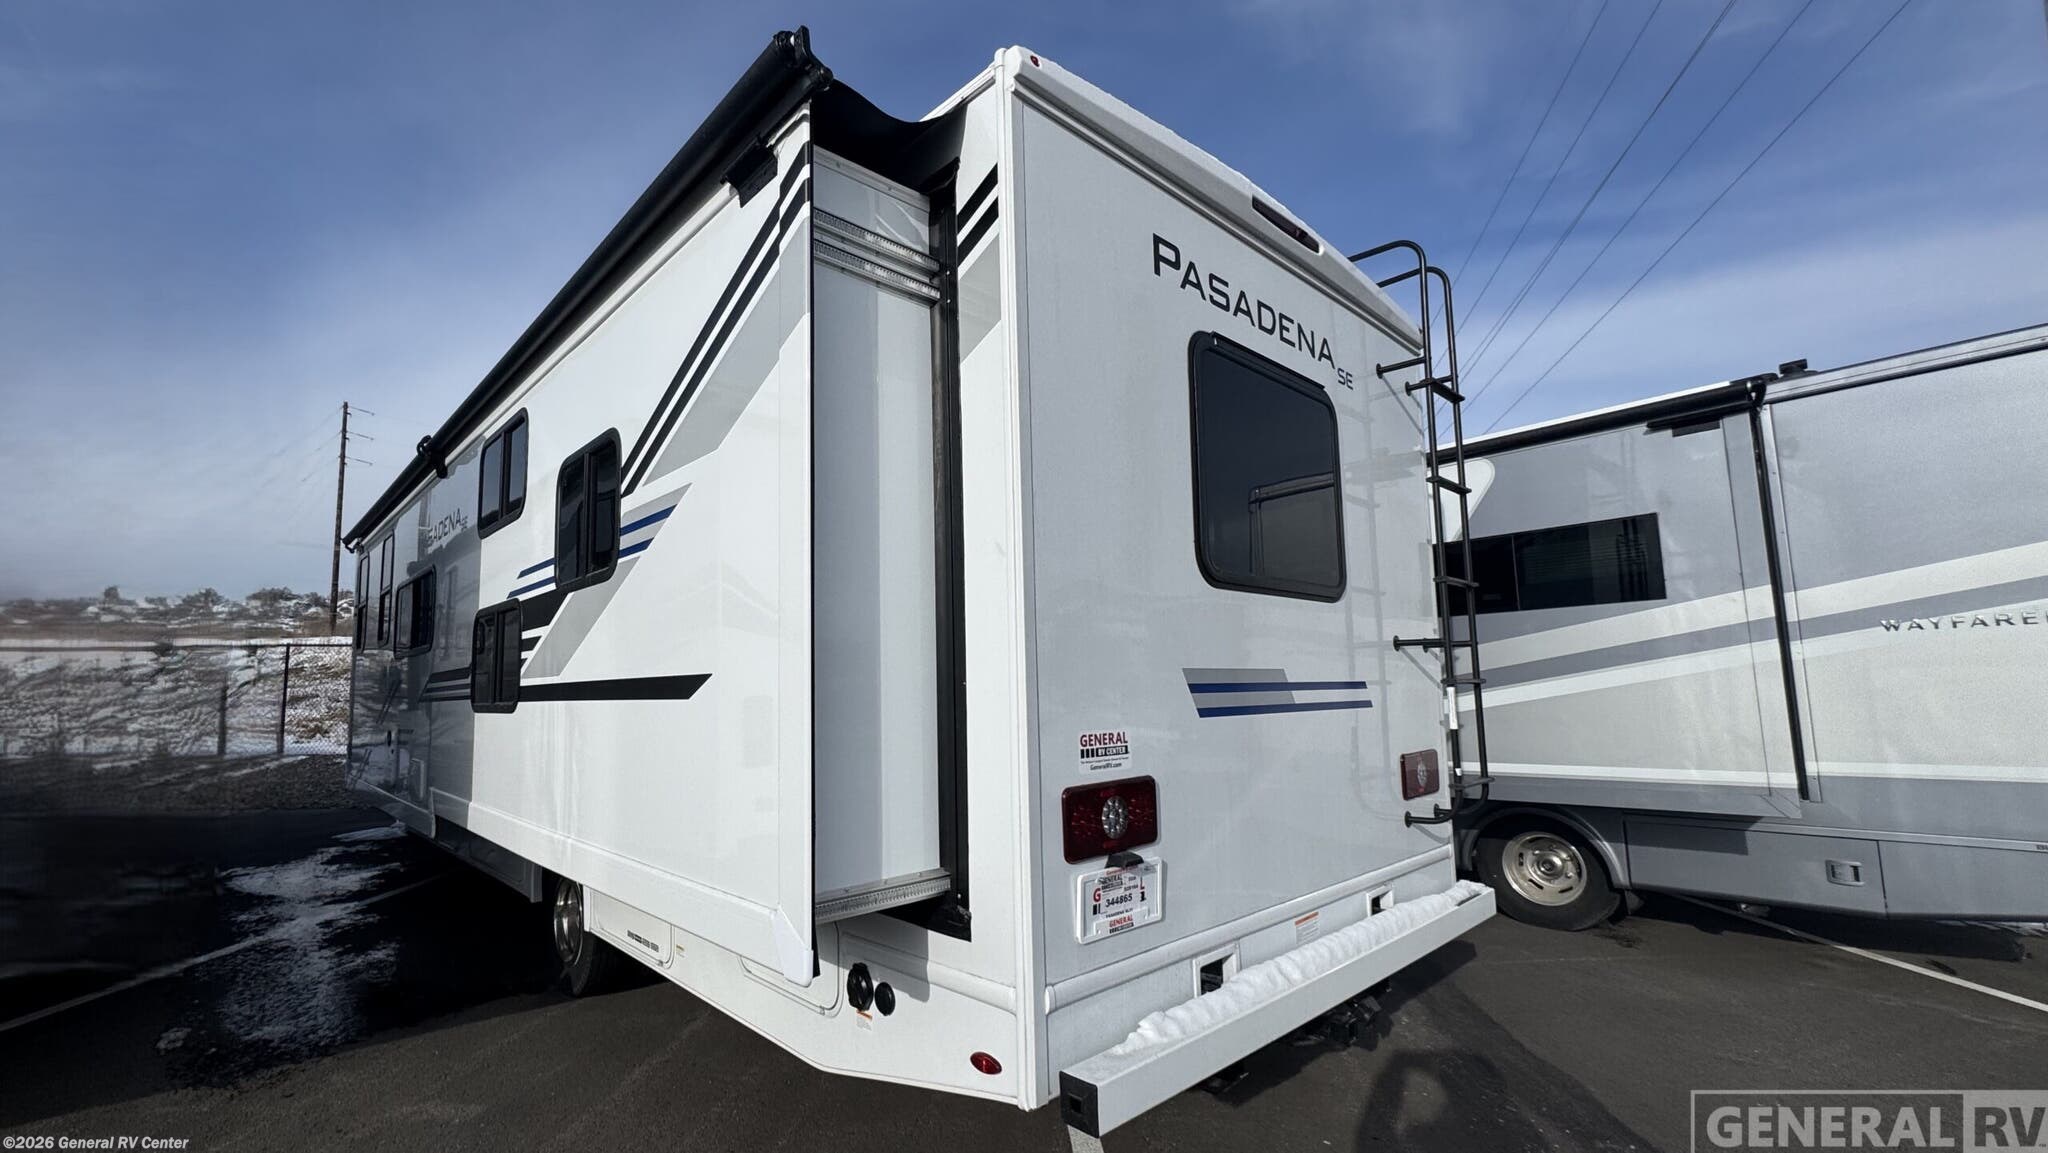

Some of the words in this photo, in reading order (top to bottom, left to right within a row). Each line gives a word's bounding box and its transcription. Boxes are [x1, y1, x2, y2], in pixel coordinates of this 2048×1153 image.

[1153, 233, 1335, 369] PASADENA
[1337, 367, 1354, 390] SE
[1880, 610, 2048, 632] WAYFARE
[1080, 731, 1128, 747] GENERAL
[1098, 748, 1105, 756] RV
[1106, 746, 1125, 755] CENTER
[1105, 893, 1133, 907] 344865
